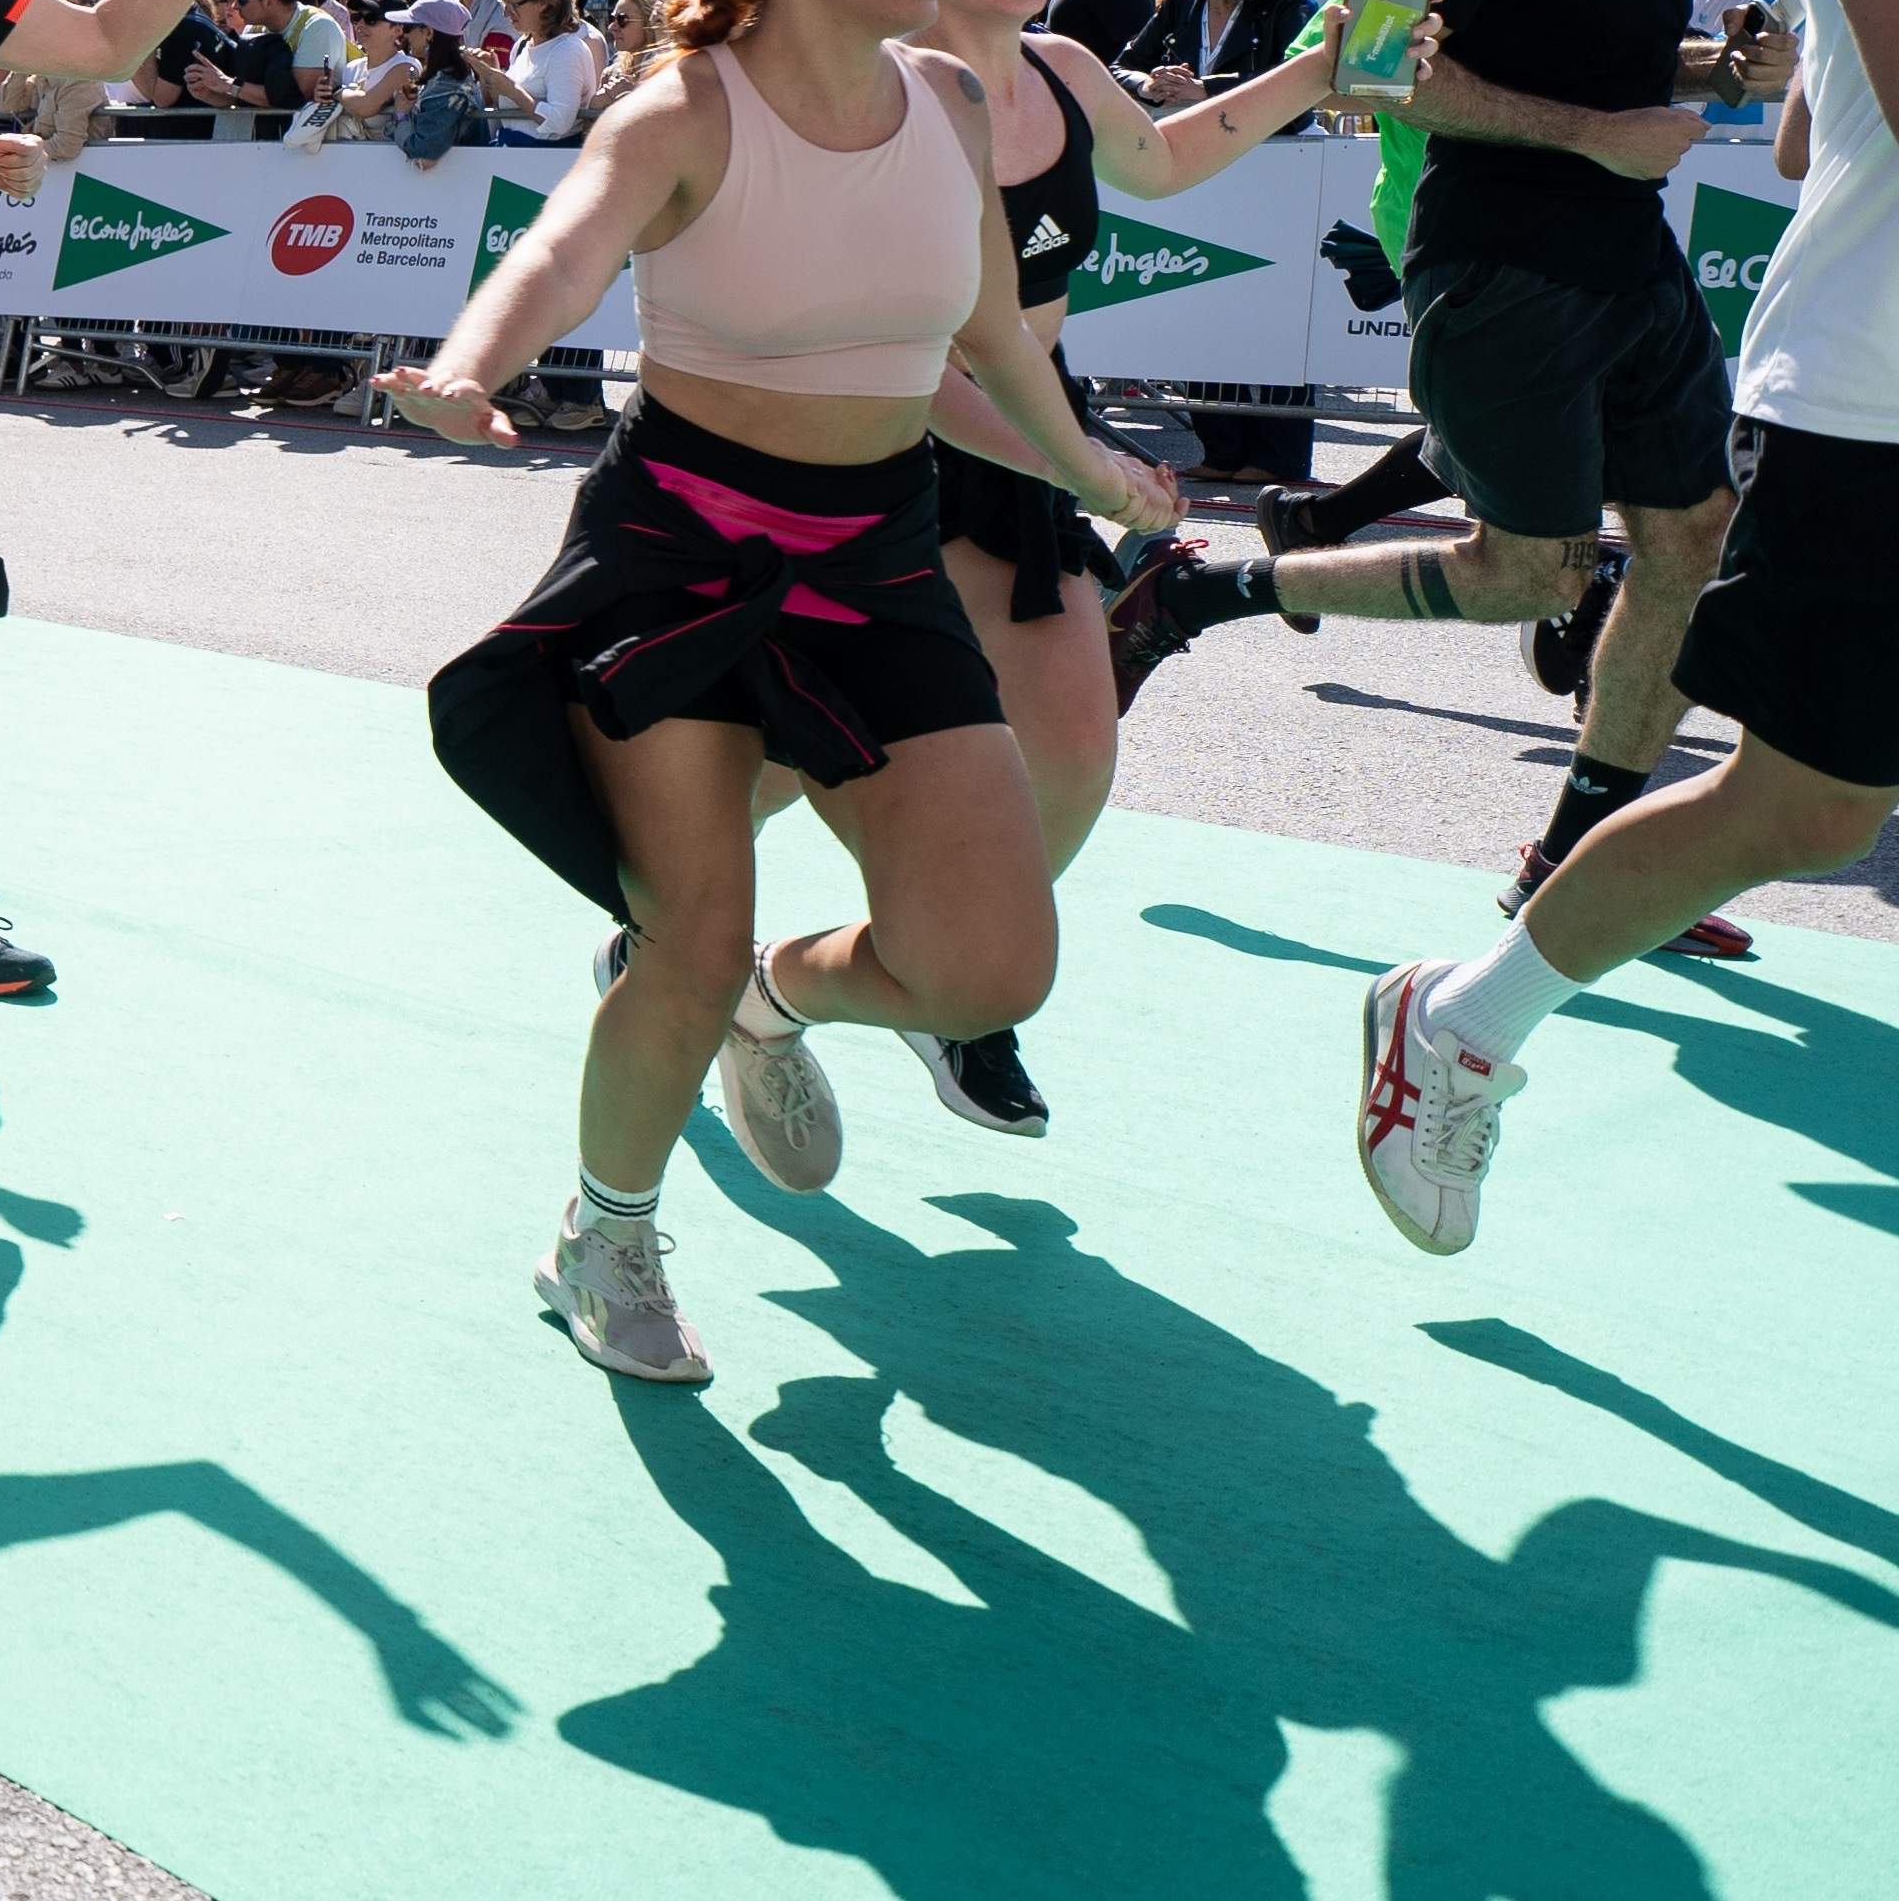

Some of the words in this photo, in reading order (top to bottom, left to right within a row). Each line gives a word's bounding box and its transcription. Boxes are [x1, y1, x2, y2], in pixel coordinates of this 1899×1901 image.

[70, 214, 89, 240] El
[88, 215, 131, 241] Corte
[129, 210, 194, 251] Inglés
[365, 212, 438, 230] Transports
[286, 224, 344, 248] TMB
[360, 231, 456, 249] Metropolitans
[1021, 232, 1070, 259] adidas
[356, 250, 374, 265] de
[376, 251, 446, 268] Barcelona
[1100, 232, 1210, 286] Inglés
[1697, 250, 1738, 289] El
[1347, 319, 1412, 339] UND
